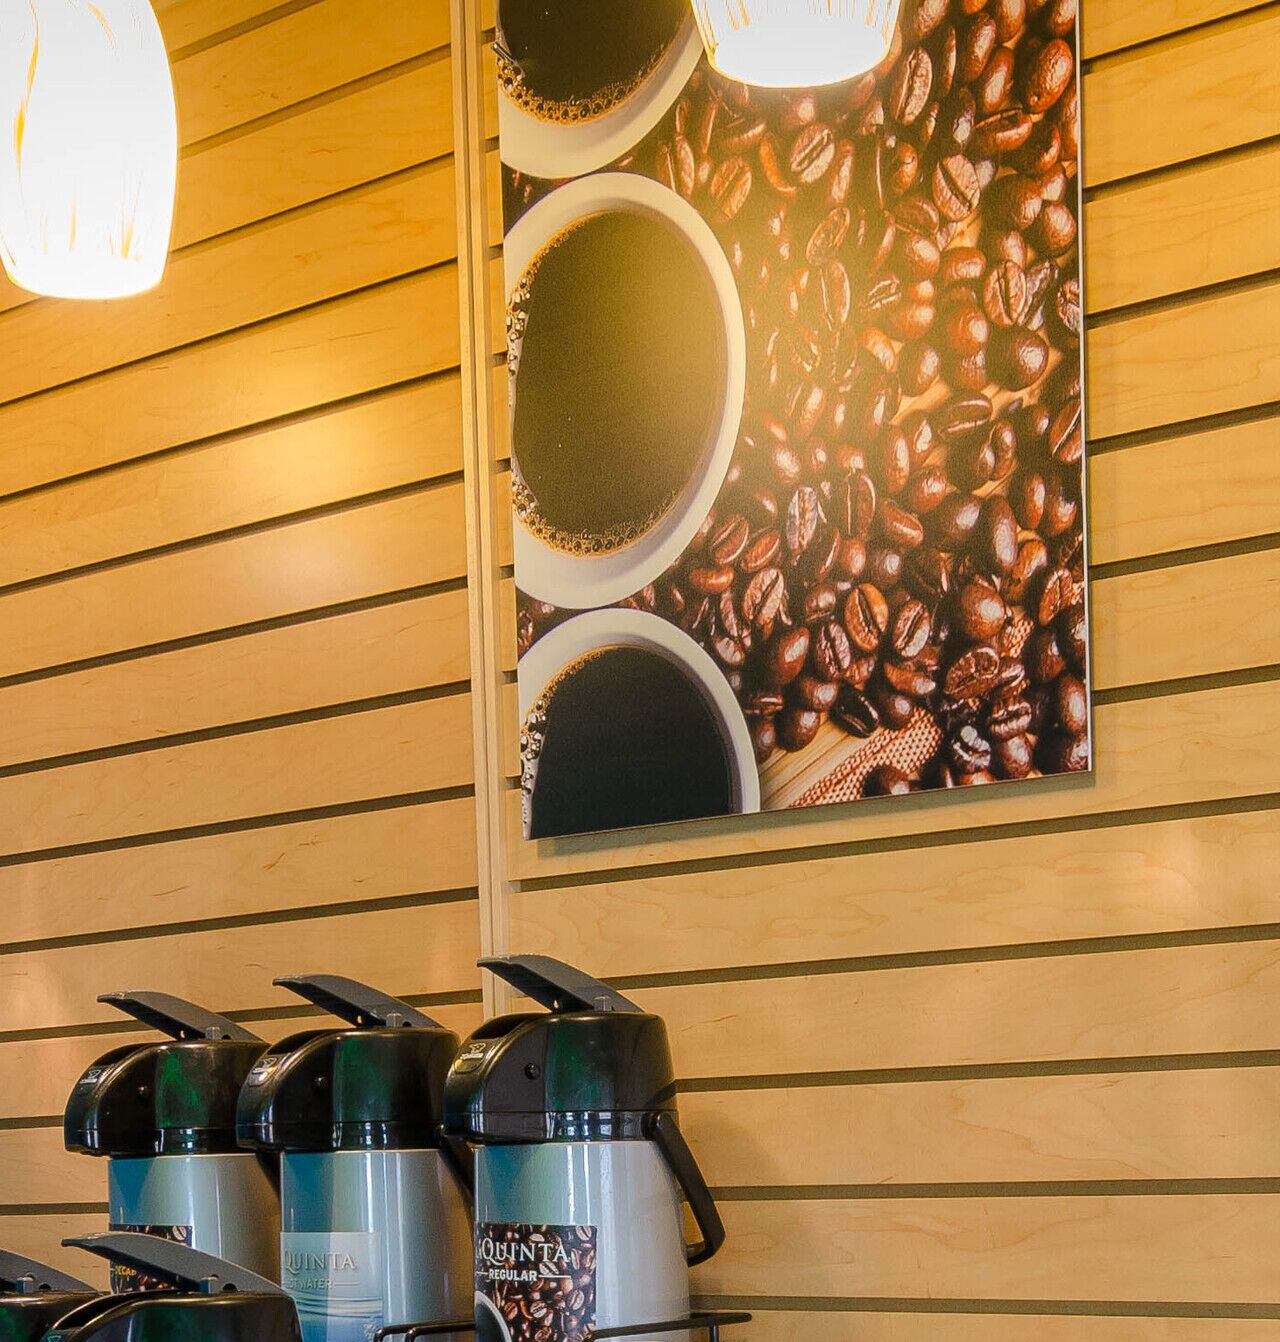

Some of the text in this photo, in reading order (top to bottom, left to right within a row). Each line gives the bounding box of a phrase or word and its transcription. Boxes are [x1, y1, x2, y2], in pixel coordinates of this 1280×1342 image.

[285, 1249, 358, 1275] QUINTA
[481, 1237, 571, 1266] QUINTA
[488, 1268, 538, 1282] REGULAR
